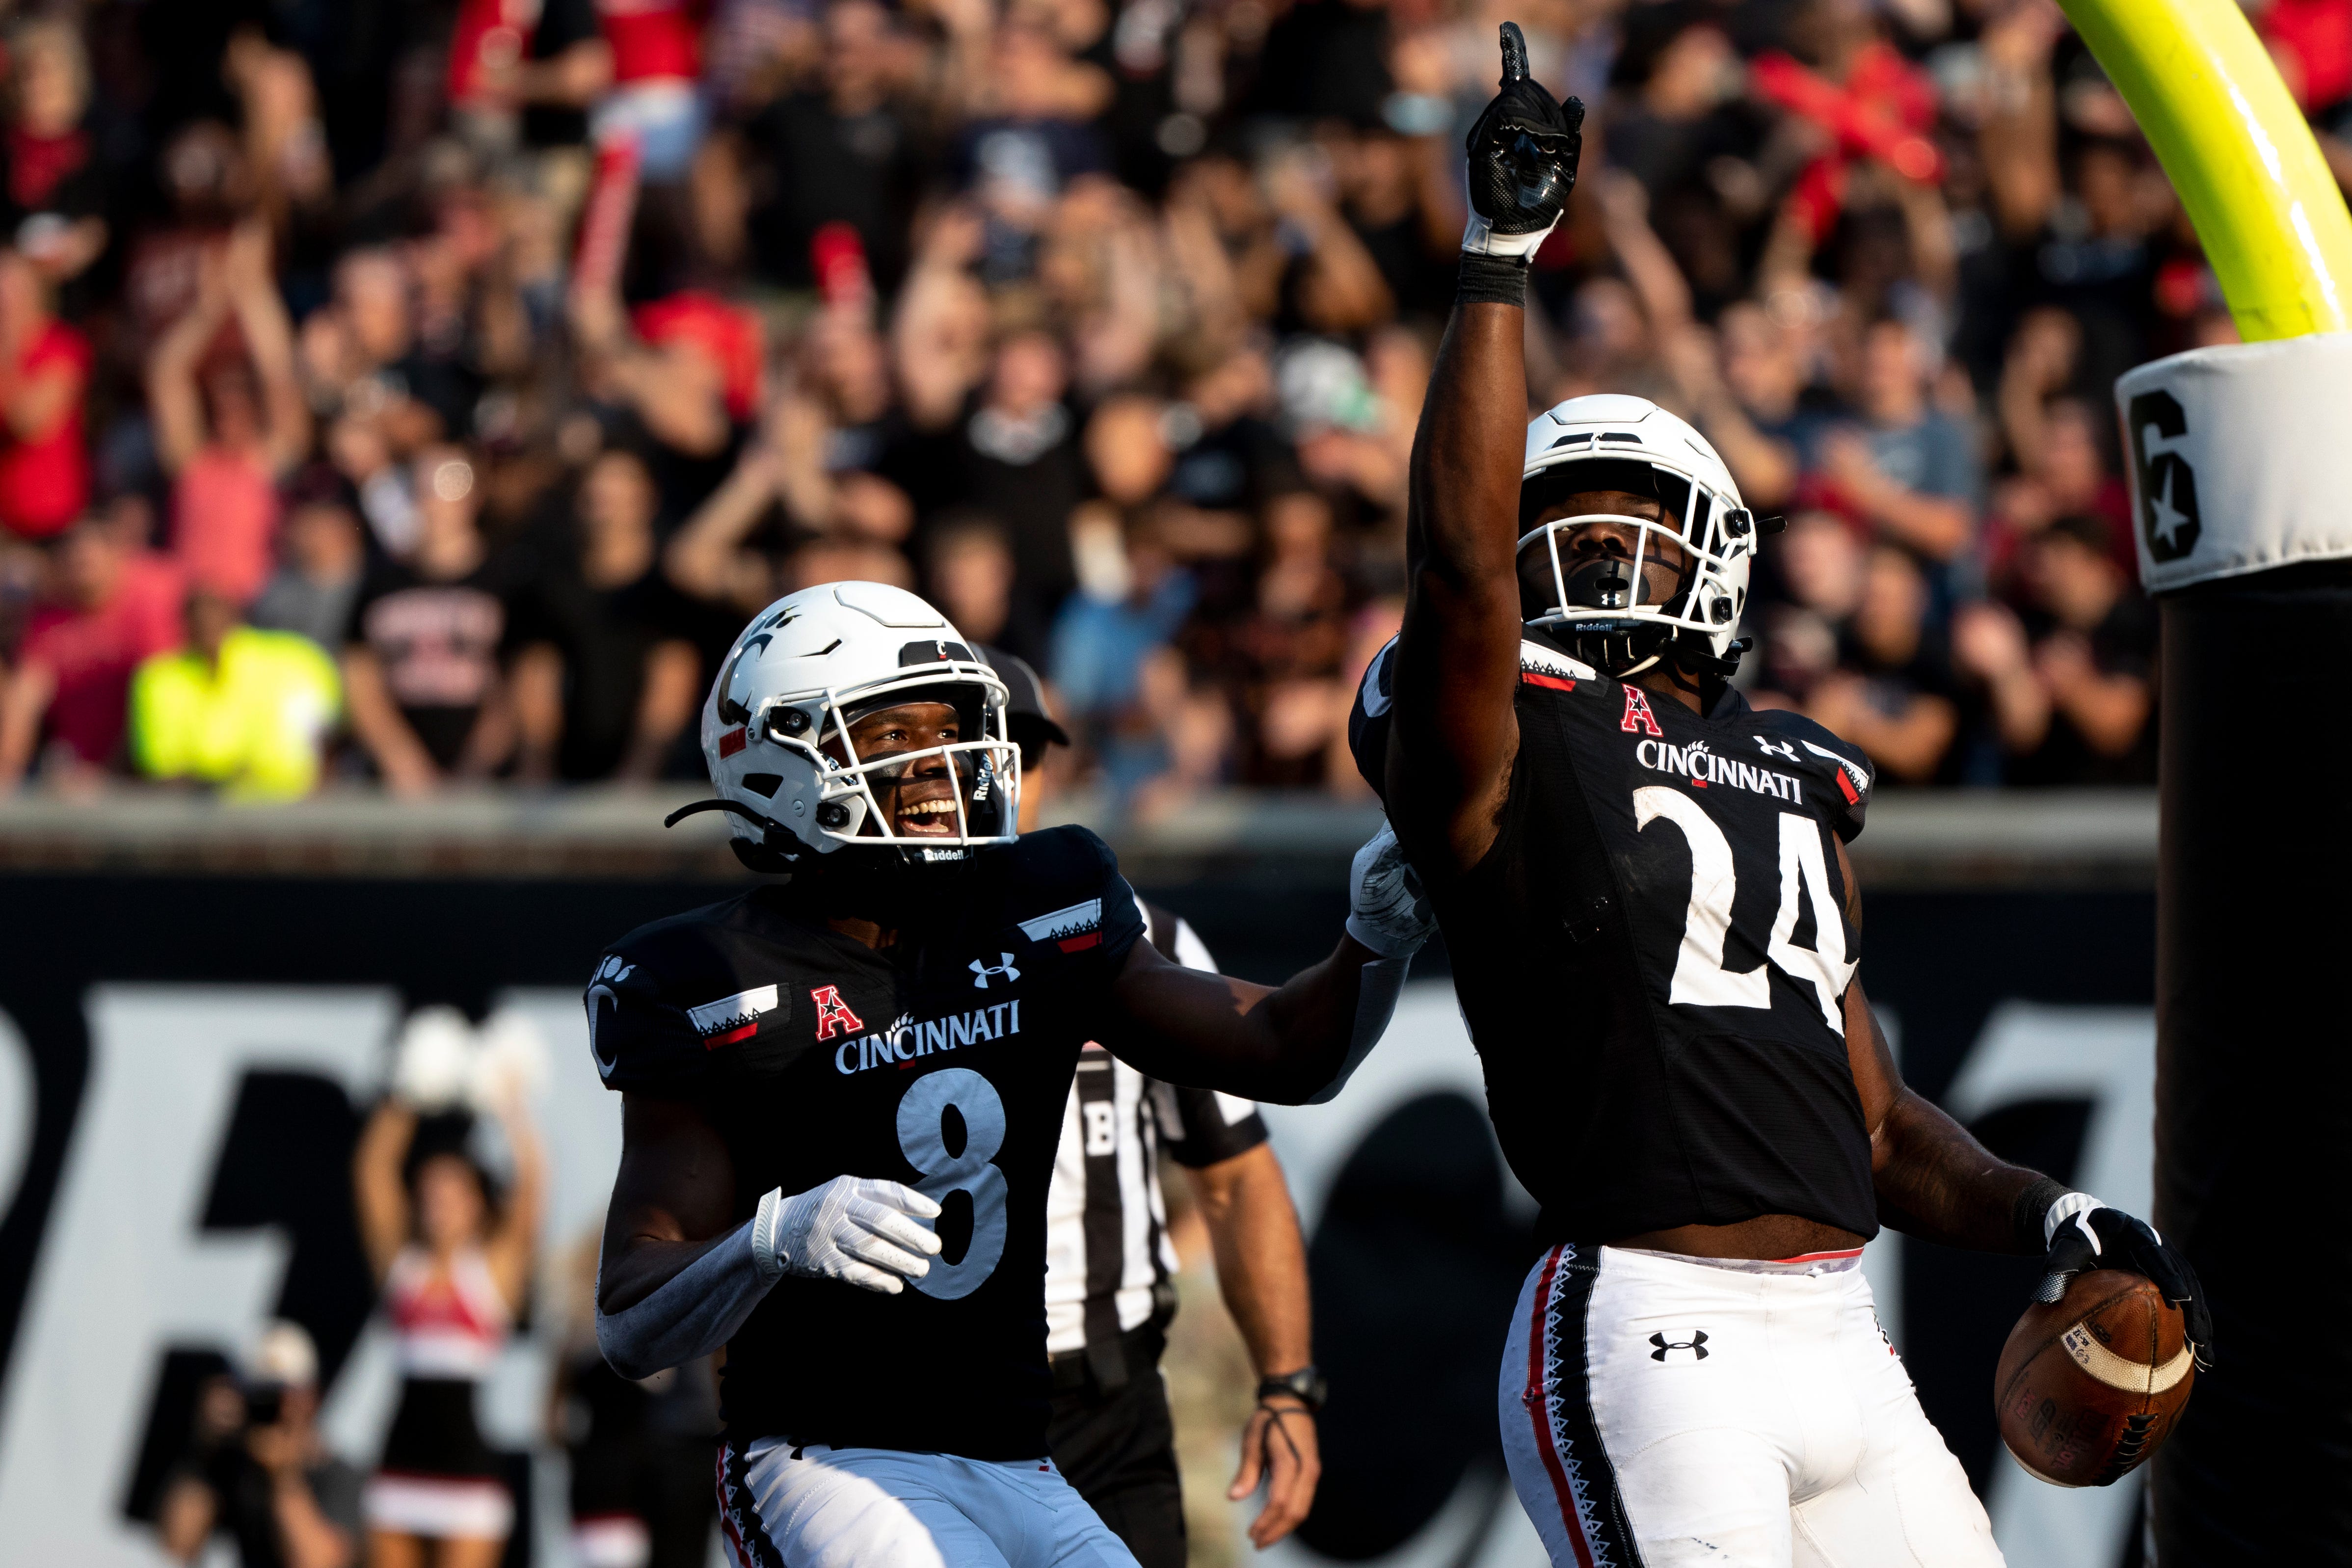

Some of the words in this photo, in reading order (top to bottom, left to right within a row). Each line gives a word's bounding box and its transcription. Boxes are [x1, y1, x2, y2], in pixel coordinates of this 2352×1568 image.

[1576, 623, 1613, 632] Riddell
[1620, 684, 1663, 738] A
[973, 753, 993, 800] Riddell
[1636, 740, 1802, 805] CINCINNATI
[923, 849, 964, 861] Riddell
[1632, 785, 1860, 1038] 24
[810, 984, 865, 1042] A
[835, 999, 1020, 1075] CINCINNATI
[1084, 1101, 1116, 1156] B
[897, 1067, 1008, 1300] 8
